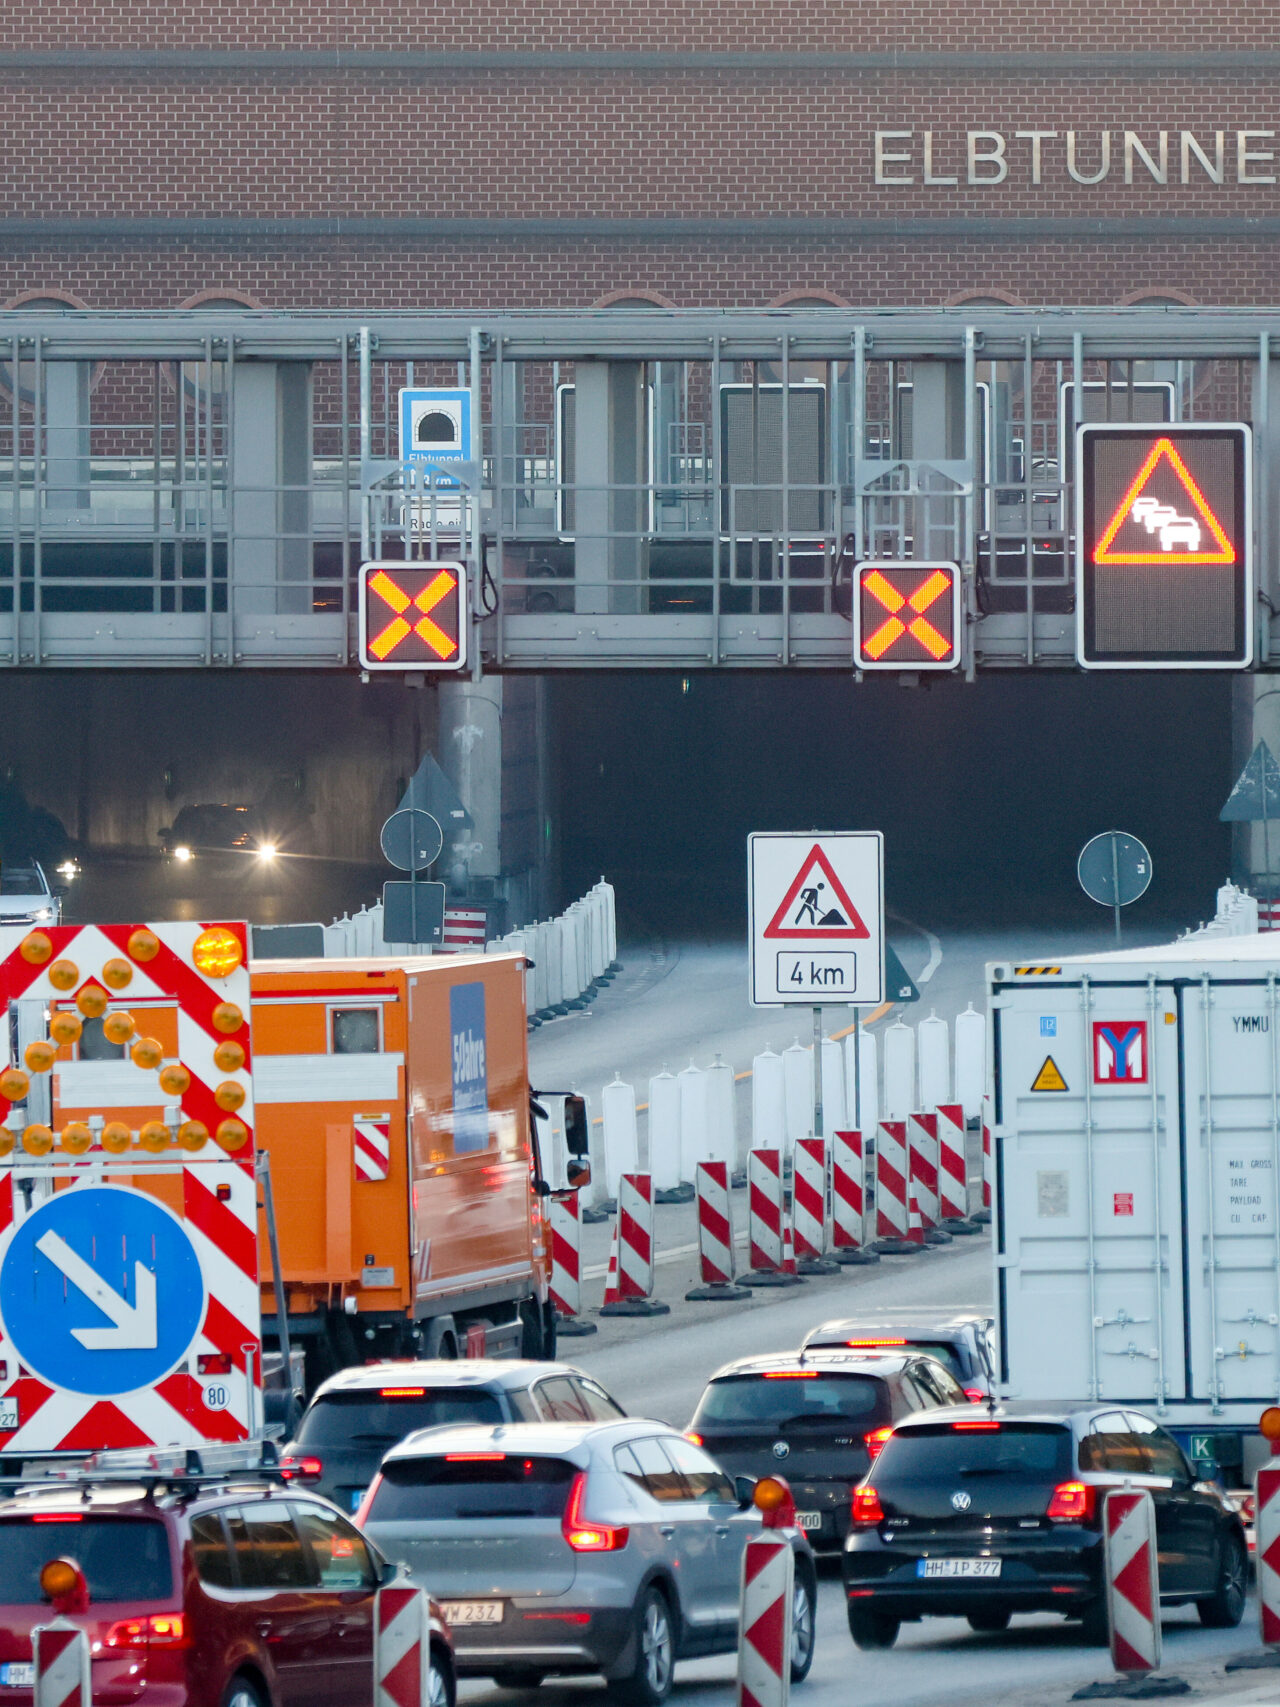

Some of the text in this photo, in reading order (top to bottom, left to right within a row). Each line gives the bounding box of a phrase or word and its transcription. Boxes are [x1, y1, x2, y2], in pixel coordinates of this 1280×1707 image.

[790, 961, 844, 985] 4 km
[1232, 1015, 1269, 1033] YMMU
[1230, 1177, 1248, 1188] TARE
[1230, 1195, 1262, 1206] PAYLOAD
[207, 1386, 225, 1405] 80
[1195, 1439, 1210, 1457] K
[926, 1561, 1000, 1576] HH IP 377
